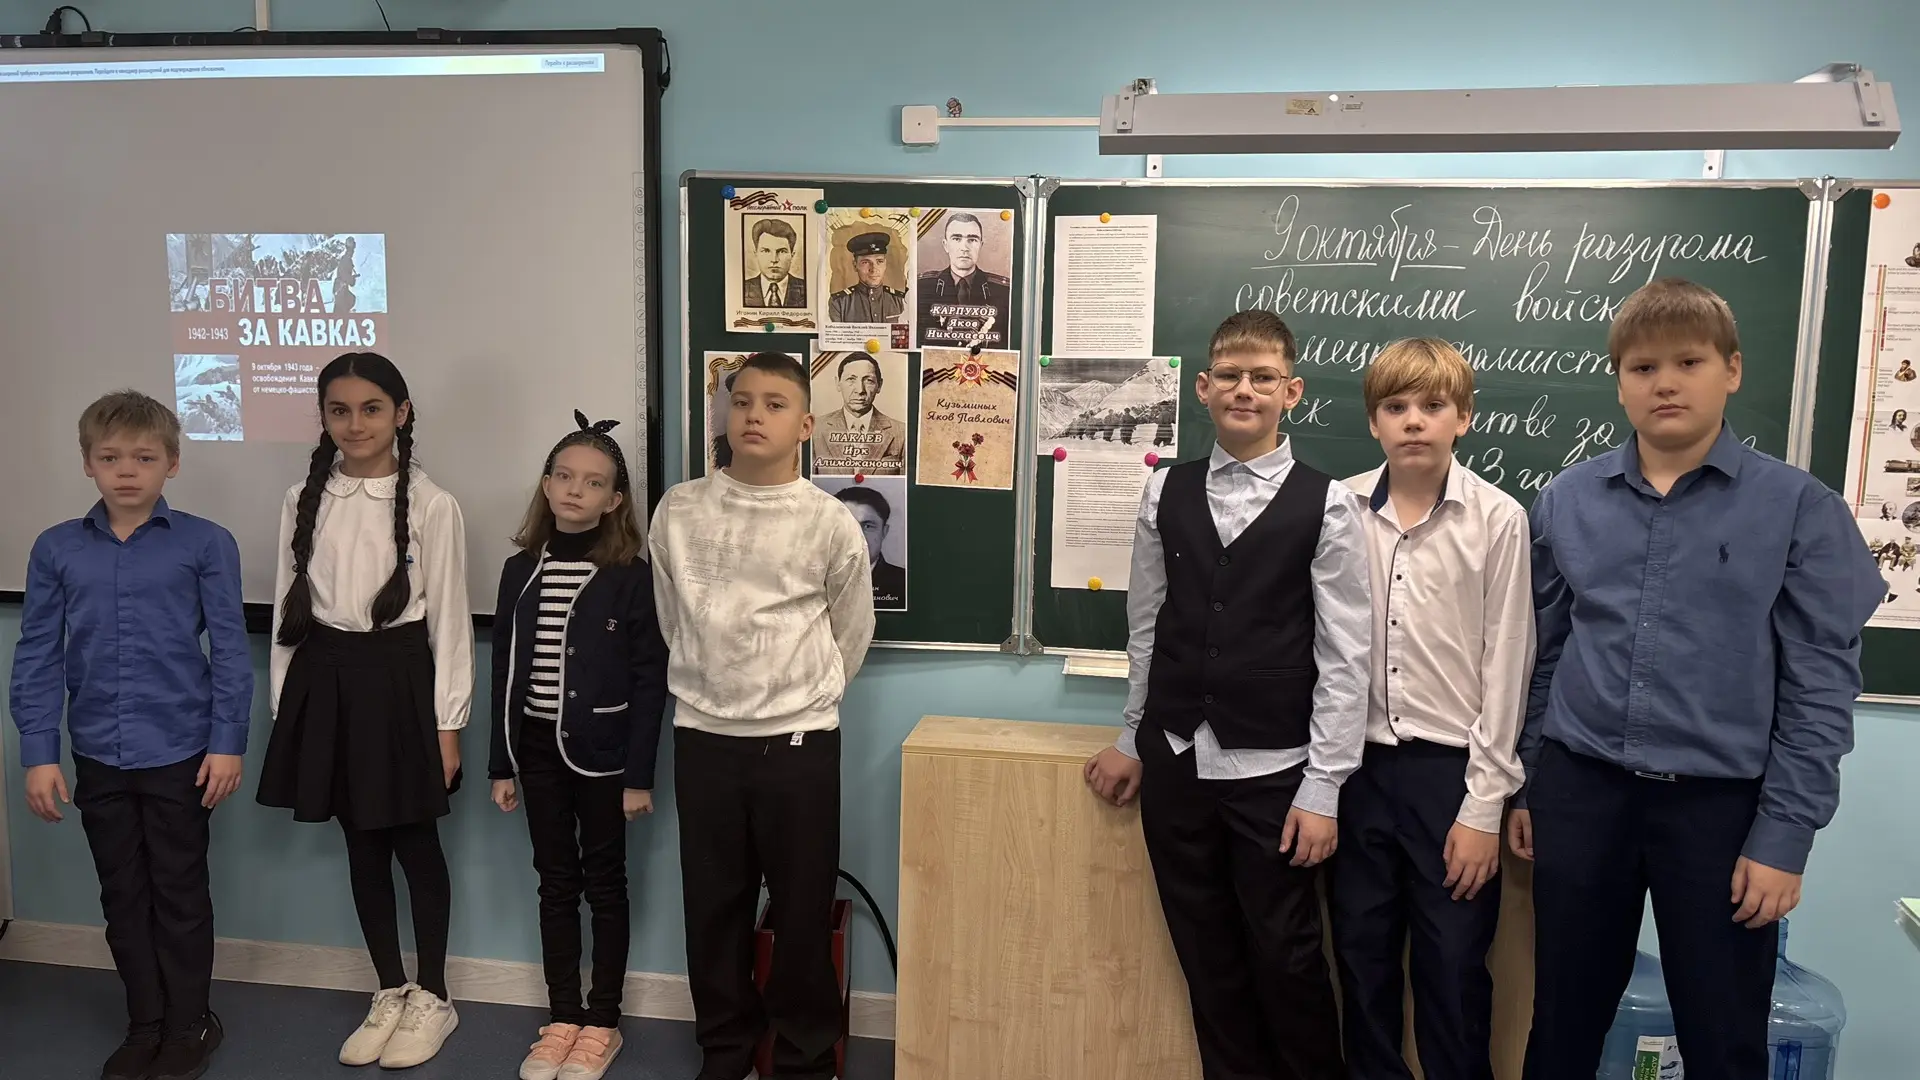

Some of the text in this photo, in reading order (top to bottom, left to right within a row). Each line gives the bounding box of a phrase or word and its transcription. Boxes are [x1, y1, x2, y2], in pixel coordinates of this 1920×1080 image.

[1296, 203, 1438, 282] октября
[1472, 204, 1554, 261] День
[207, 277, 333, 314] БИТВА
[1235, 260, 1627, 323] советскими войск
[930, 305, 998, 317] КАРПУХОВ
[948, 318, 979, 328] Яков
[187, 327, 229, 340] 1942-1943
[238, 317, 377, 347] ЗА КАВКАЗ
[926, 329, 1001, 341] Николаевич
[299, 374, 319, 383] Кавка
[936, 398, 997, 411] Кузьминых
[926, 410, 1011, 425] Яков Павлович
[829, 432, 883, 443] МАКАЕВ
[813, 456, 903, 468] Алимджанович
